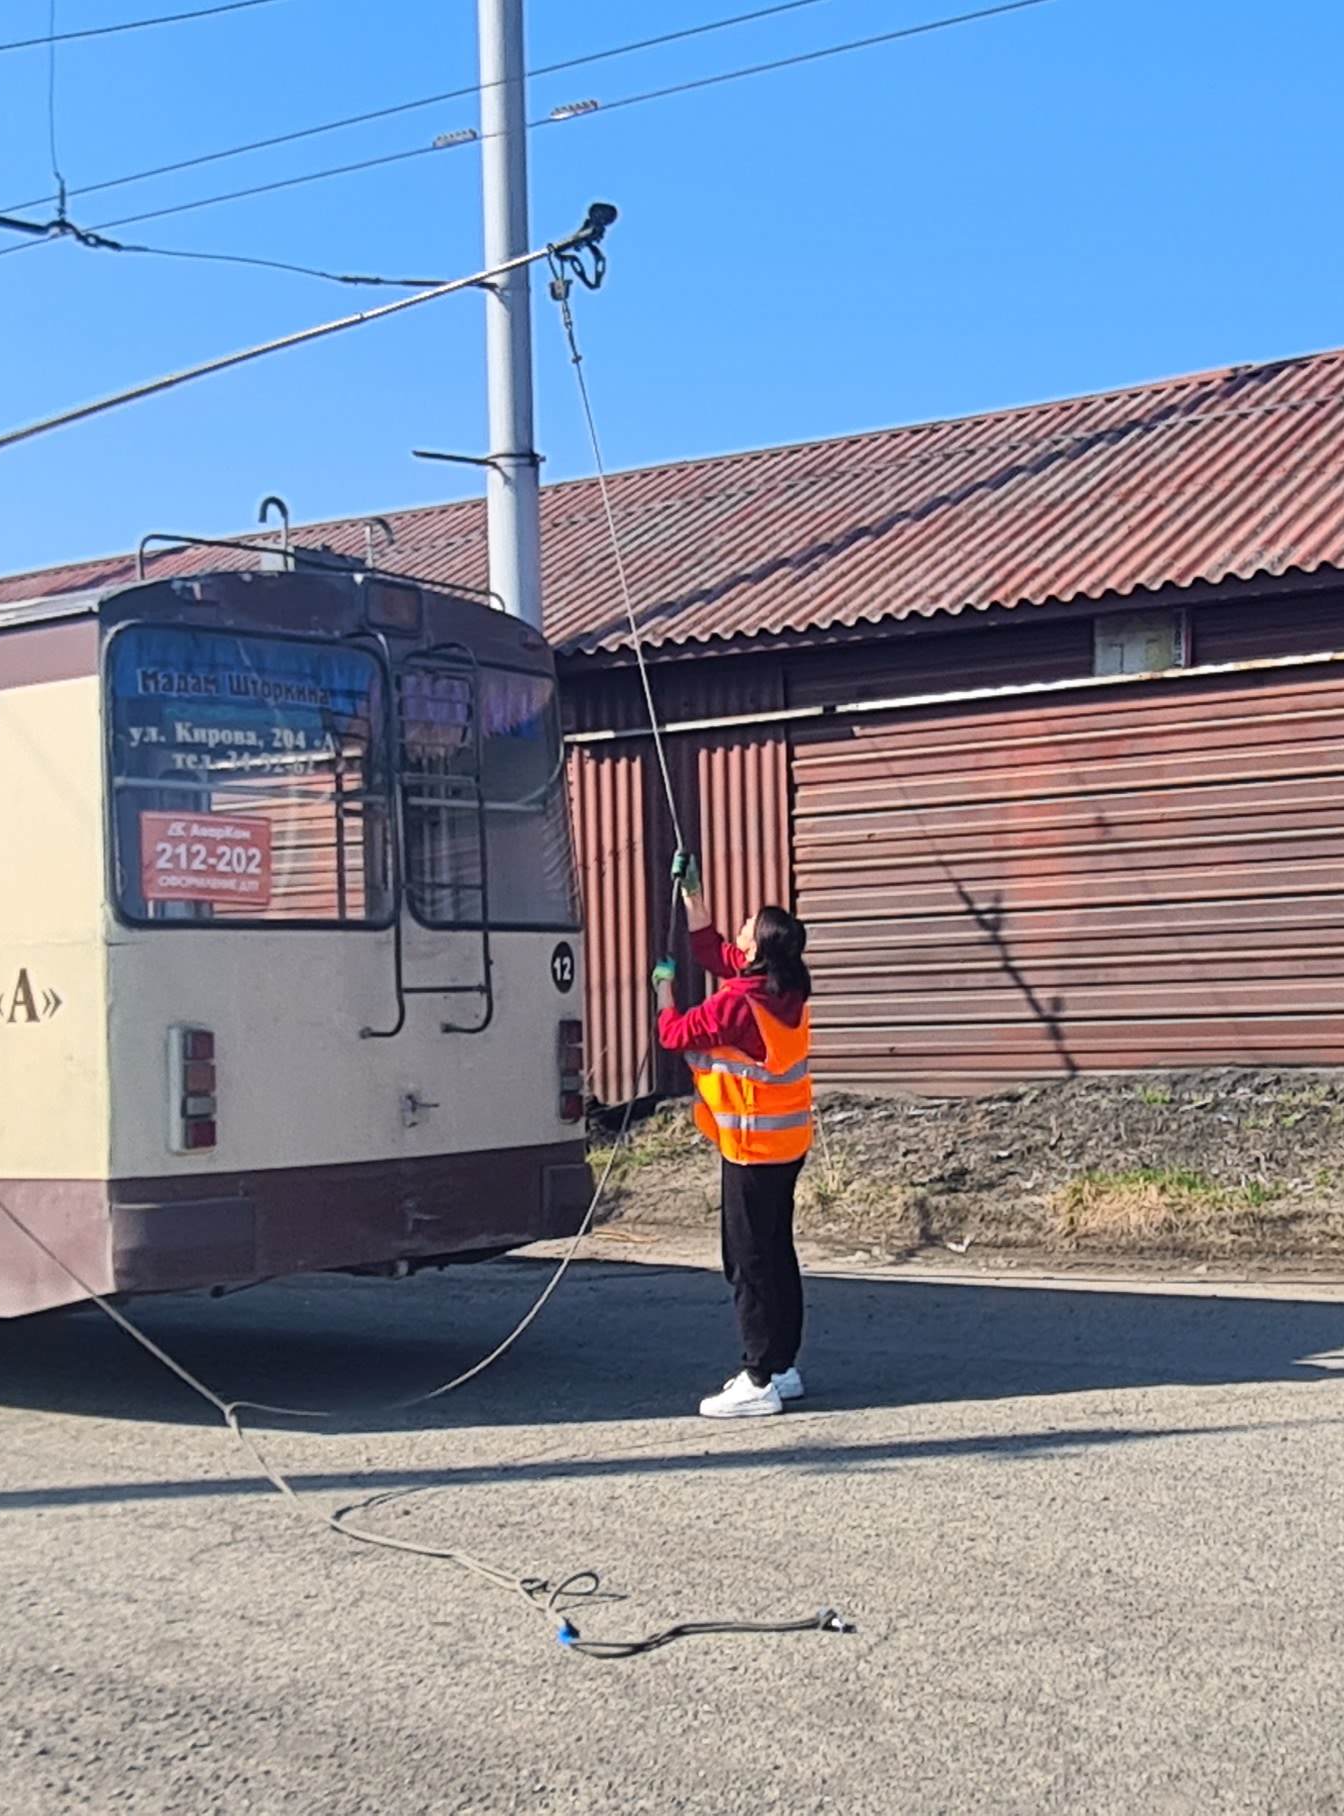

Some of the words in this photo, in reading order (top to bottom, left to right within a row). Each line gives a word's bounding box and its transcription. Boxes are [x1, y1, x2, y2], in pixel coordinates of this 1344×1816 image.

[137, 667, 221, 697] Мадам
[227, 671, 331, 706] Шторкина
[128, 725, 166, 747] ул.
[174, 721, 265, 749] Кирова,
[271, 727, 306, 749] 204
[155, 842, 262, 875] 212-202
[554, 956, 572, 980] 12
